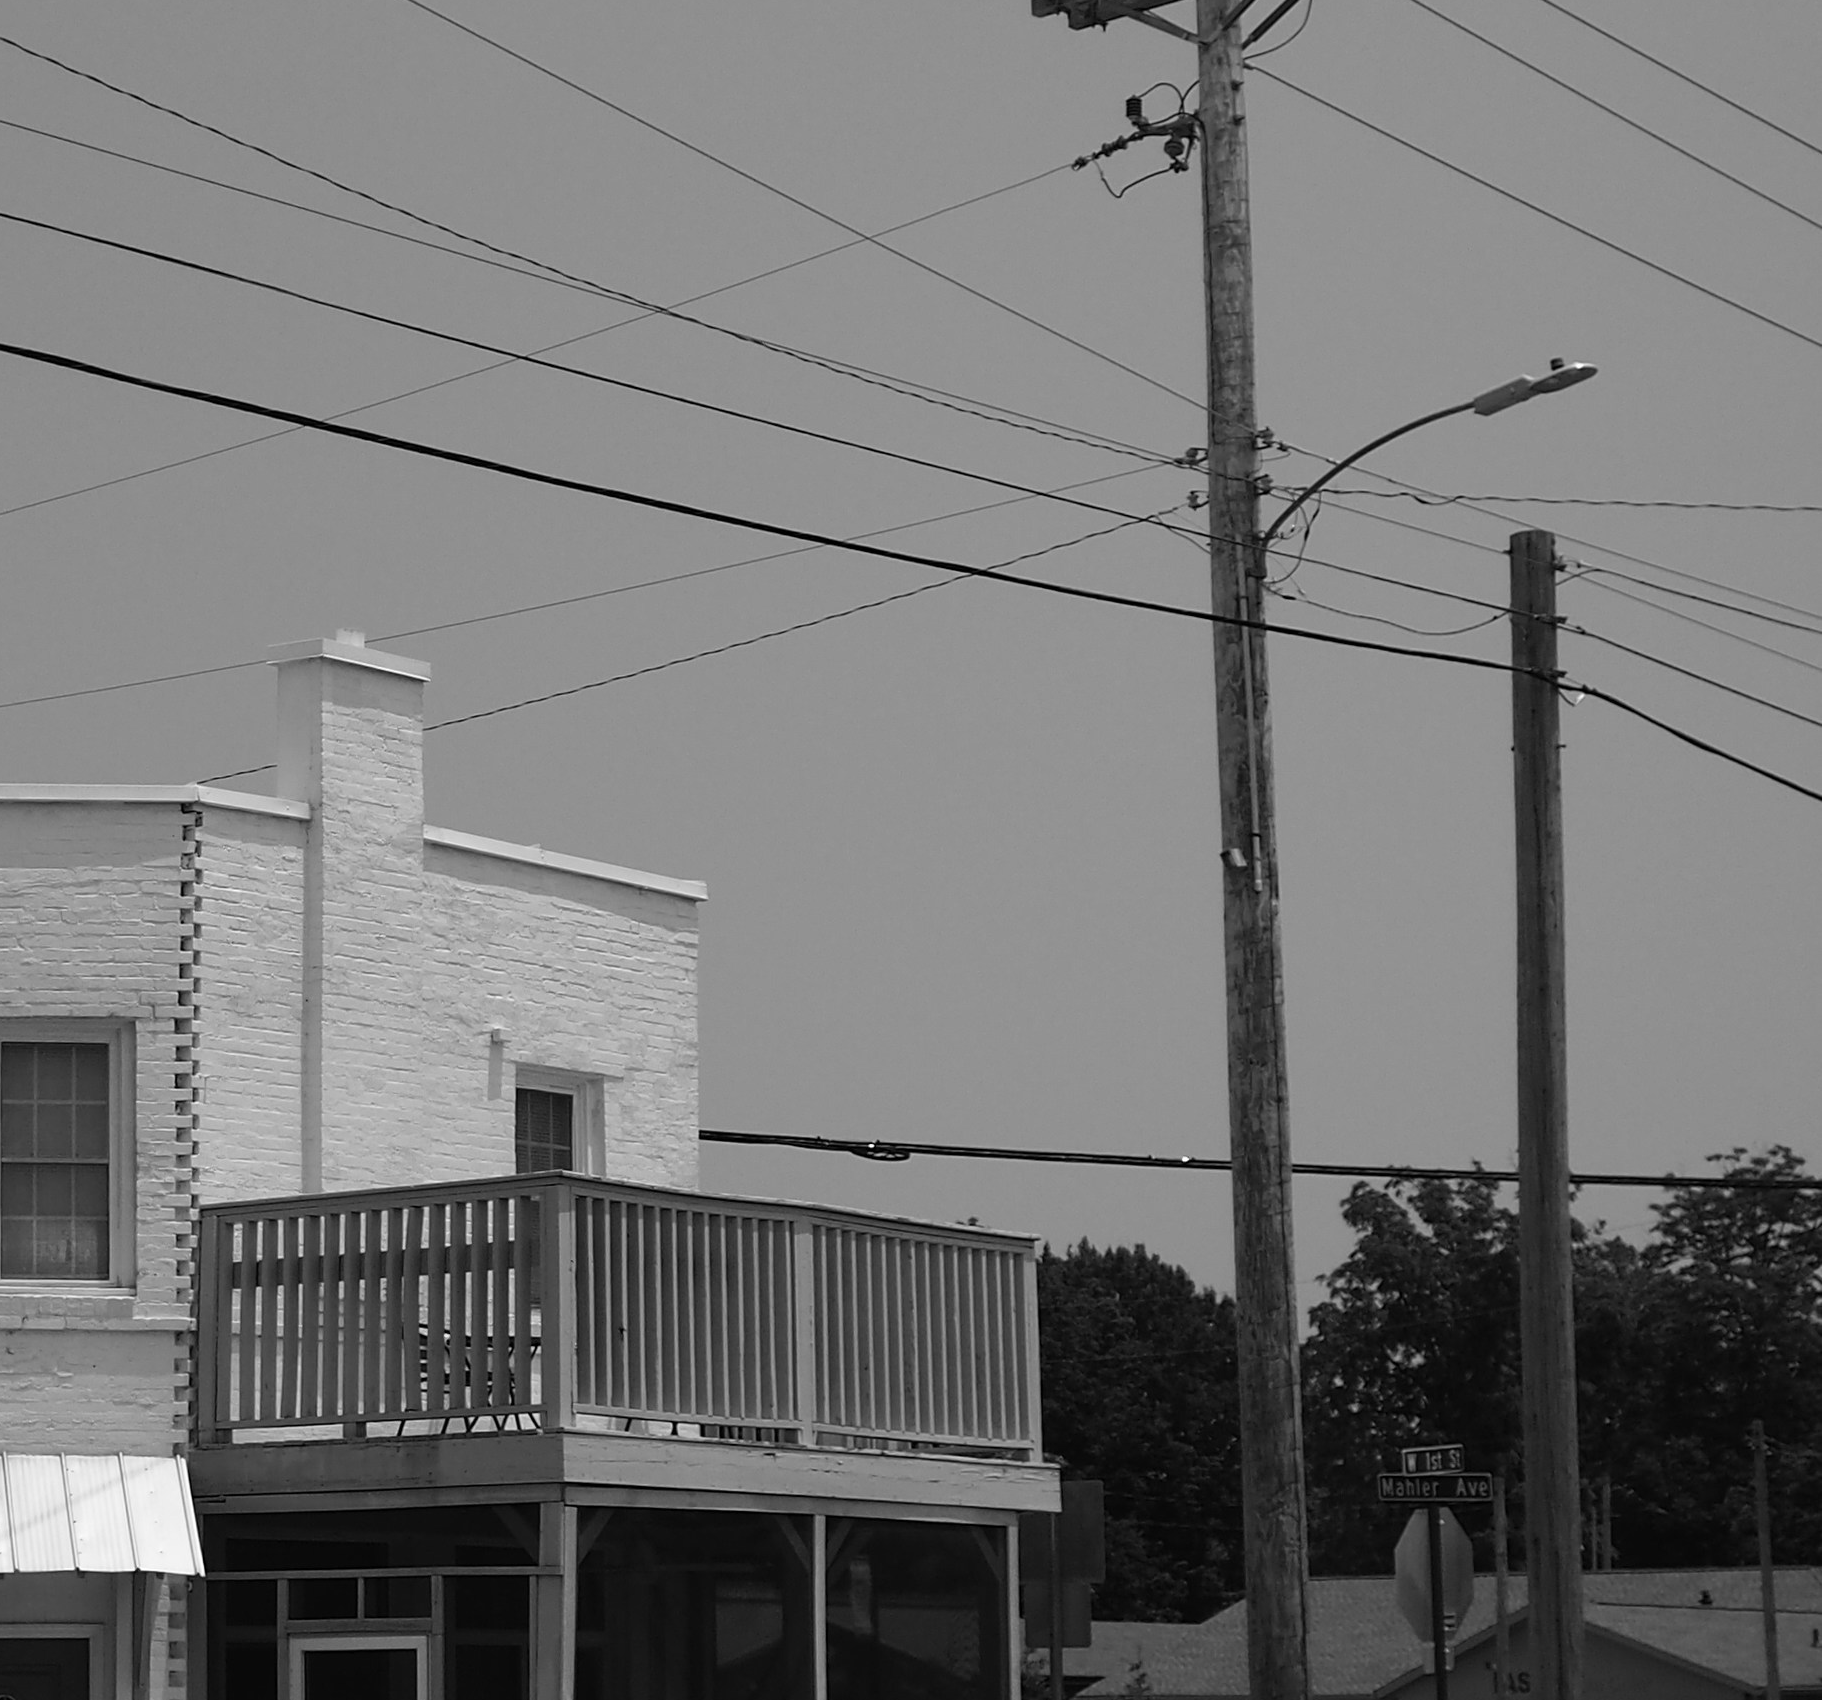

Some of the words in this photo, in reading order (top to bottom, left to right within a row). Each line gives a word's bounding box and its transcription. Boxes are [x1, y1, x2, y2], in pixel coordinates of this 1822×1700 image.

[1425, 1451, 1443, 1471] 1st
[1448, 1449, 1461, 1469] St
[1381, 1477, 1441, 1497] Mahler
[1456, 1477, 1488, 1497] Ave
